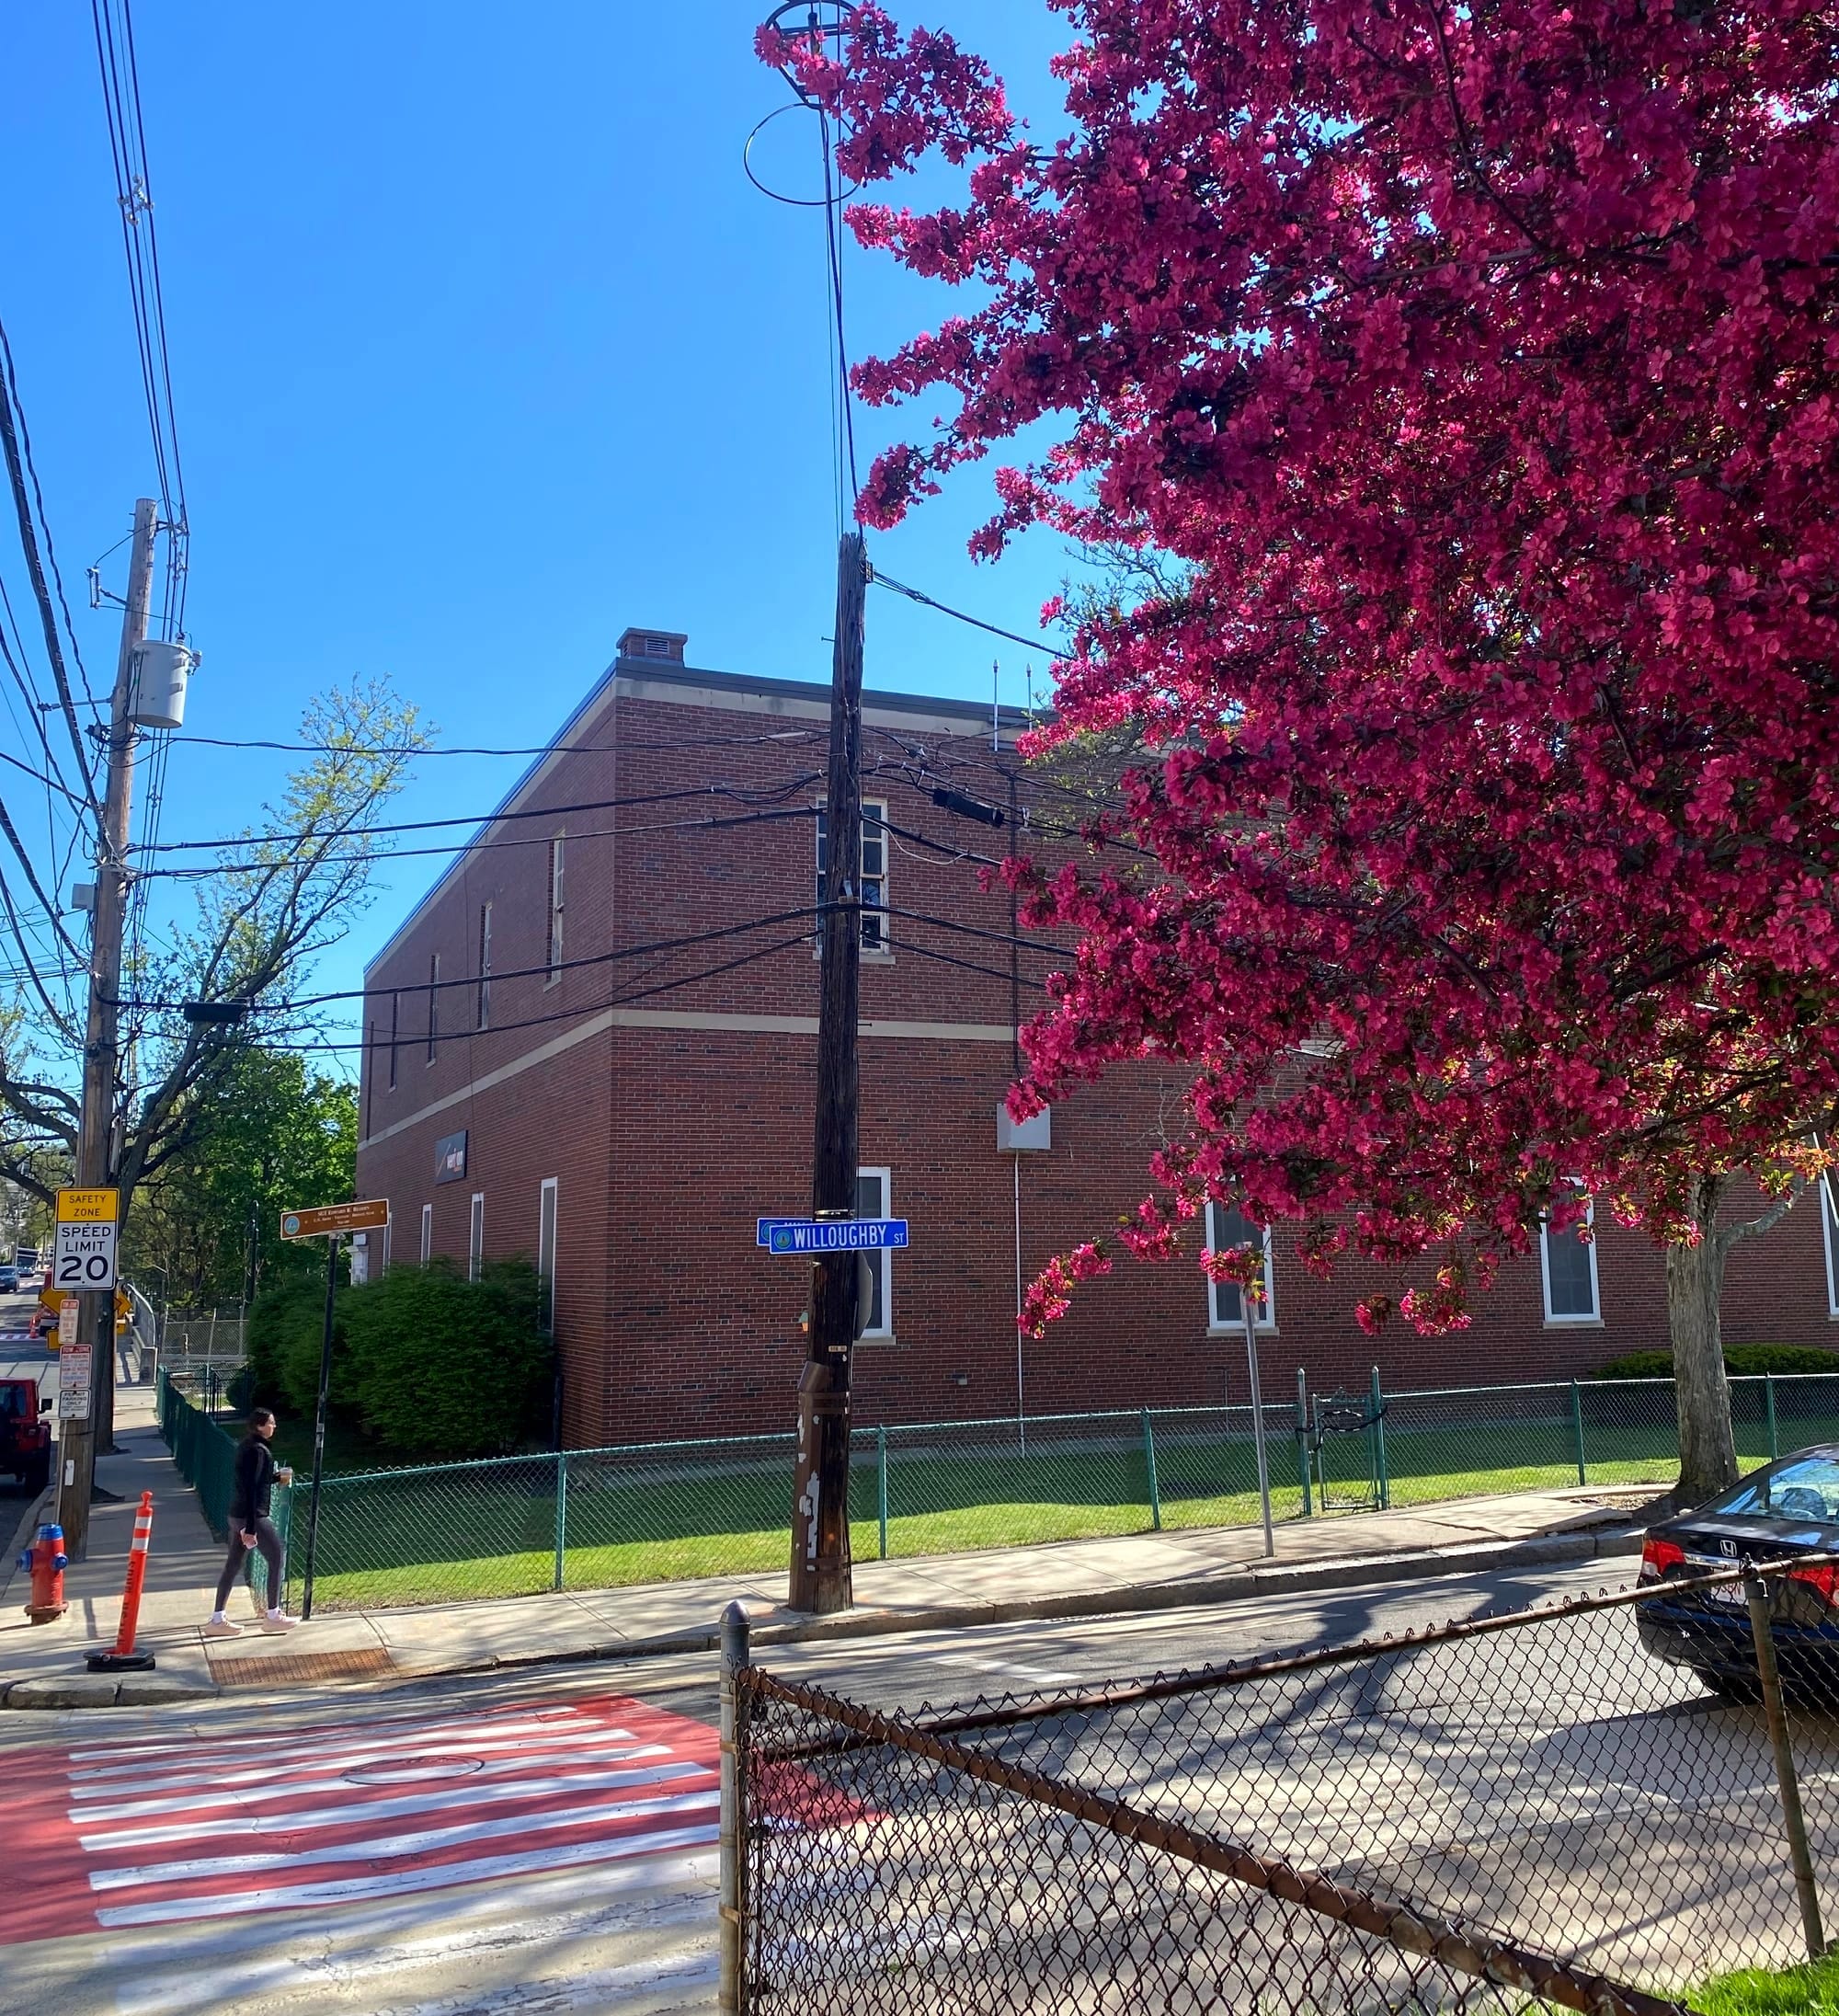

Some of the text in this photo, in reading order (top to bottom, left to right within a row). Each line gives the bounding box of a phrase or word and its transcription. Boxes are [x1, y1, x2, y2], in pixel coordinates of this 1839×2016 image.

[69, 1195, 107, 1204] SAFETY
[74, 1208, 101, 1217] ZONE
[62, 1227, 111, 1237] SPEED
[794, 1224, 905, 1249] WILLOUGHBY ST
[65, 1241, 106, 1252] LIMIT
[59, 1255, 109, 1281] 20
